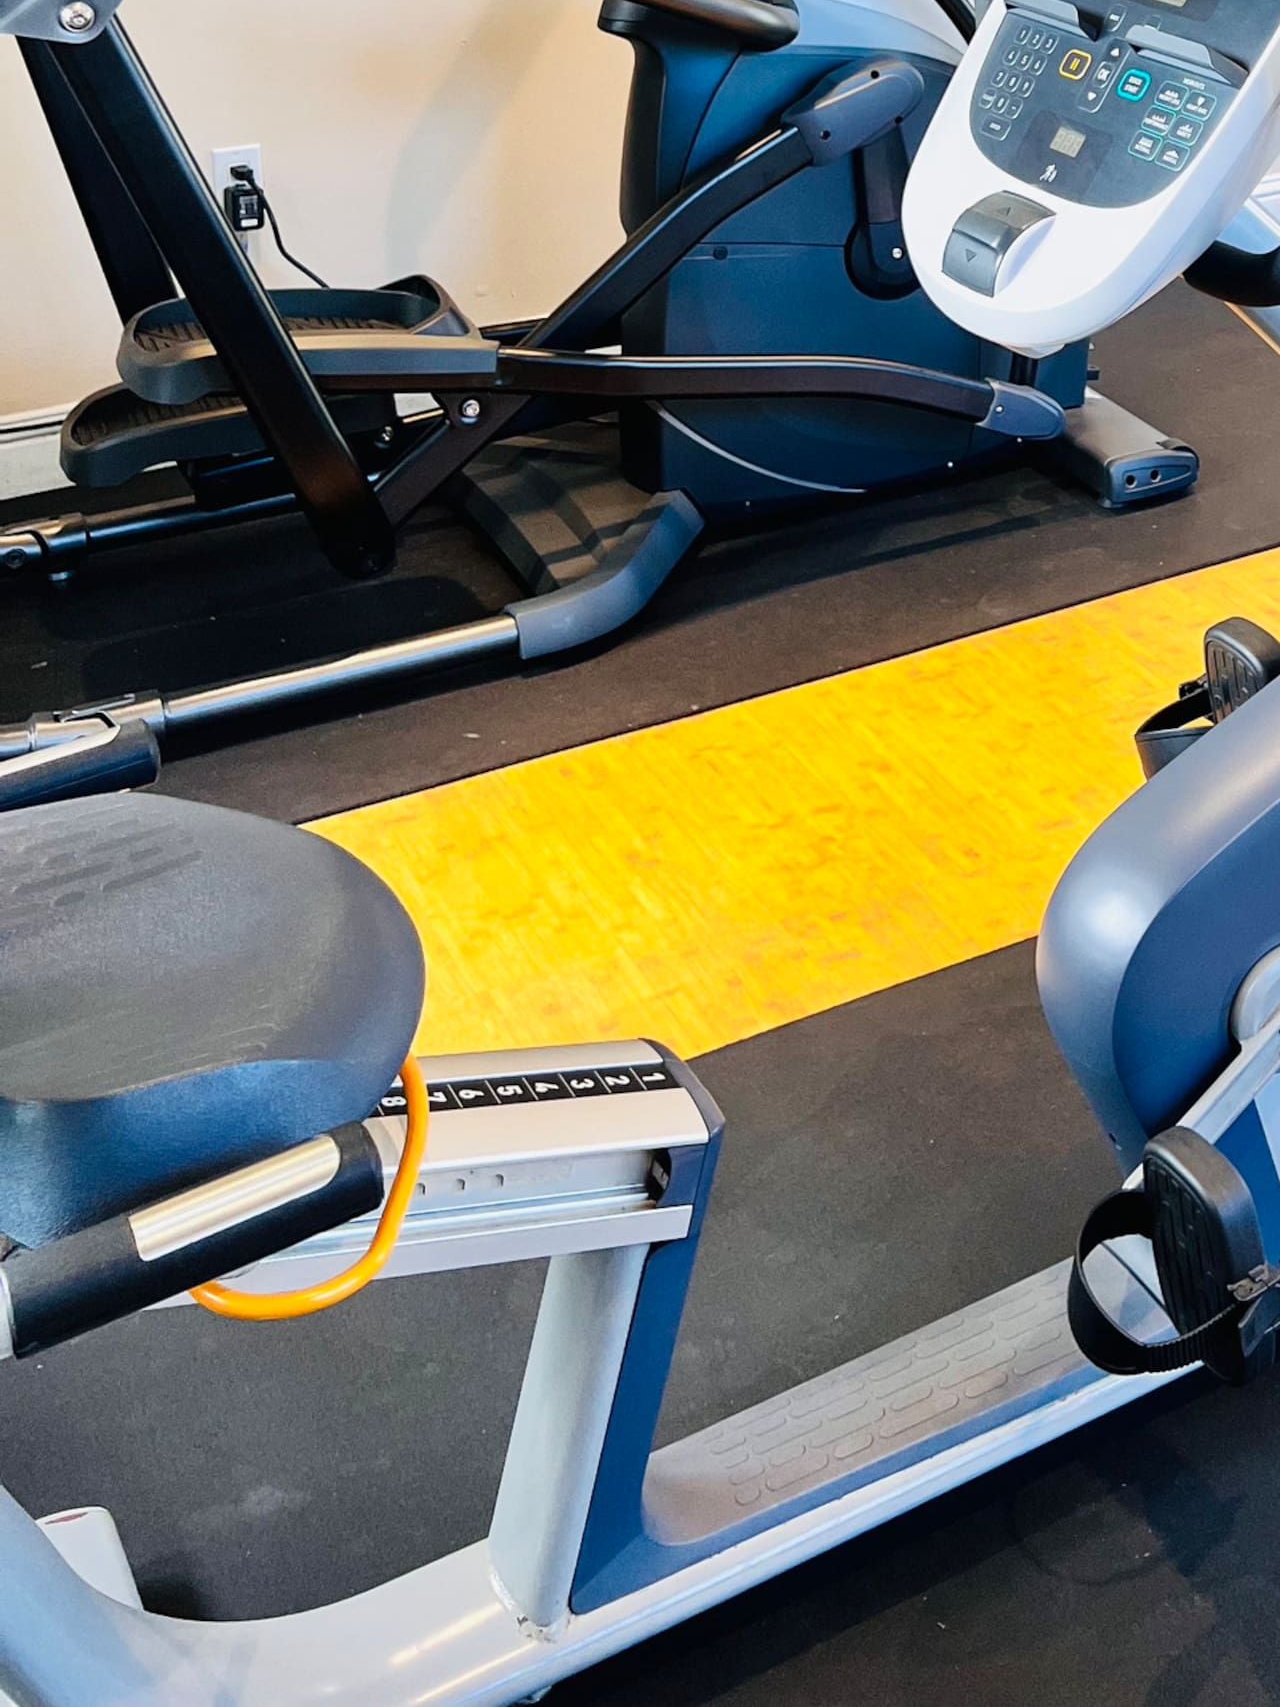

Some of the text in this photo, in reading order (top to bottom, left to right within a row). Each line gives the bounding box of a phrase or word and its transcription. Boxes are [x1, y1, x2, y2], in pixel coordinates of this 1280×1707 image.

[570, 1077, 595, 1090] 3
[607, 1075, 631, 1087] 2
[496, 1085, 523, 1097] 5
[381, 1095, 407, 1108] 8
